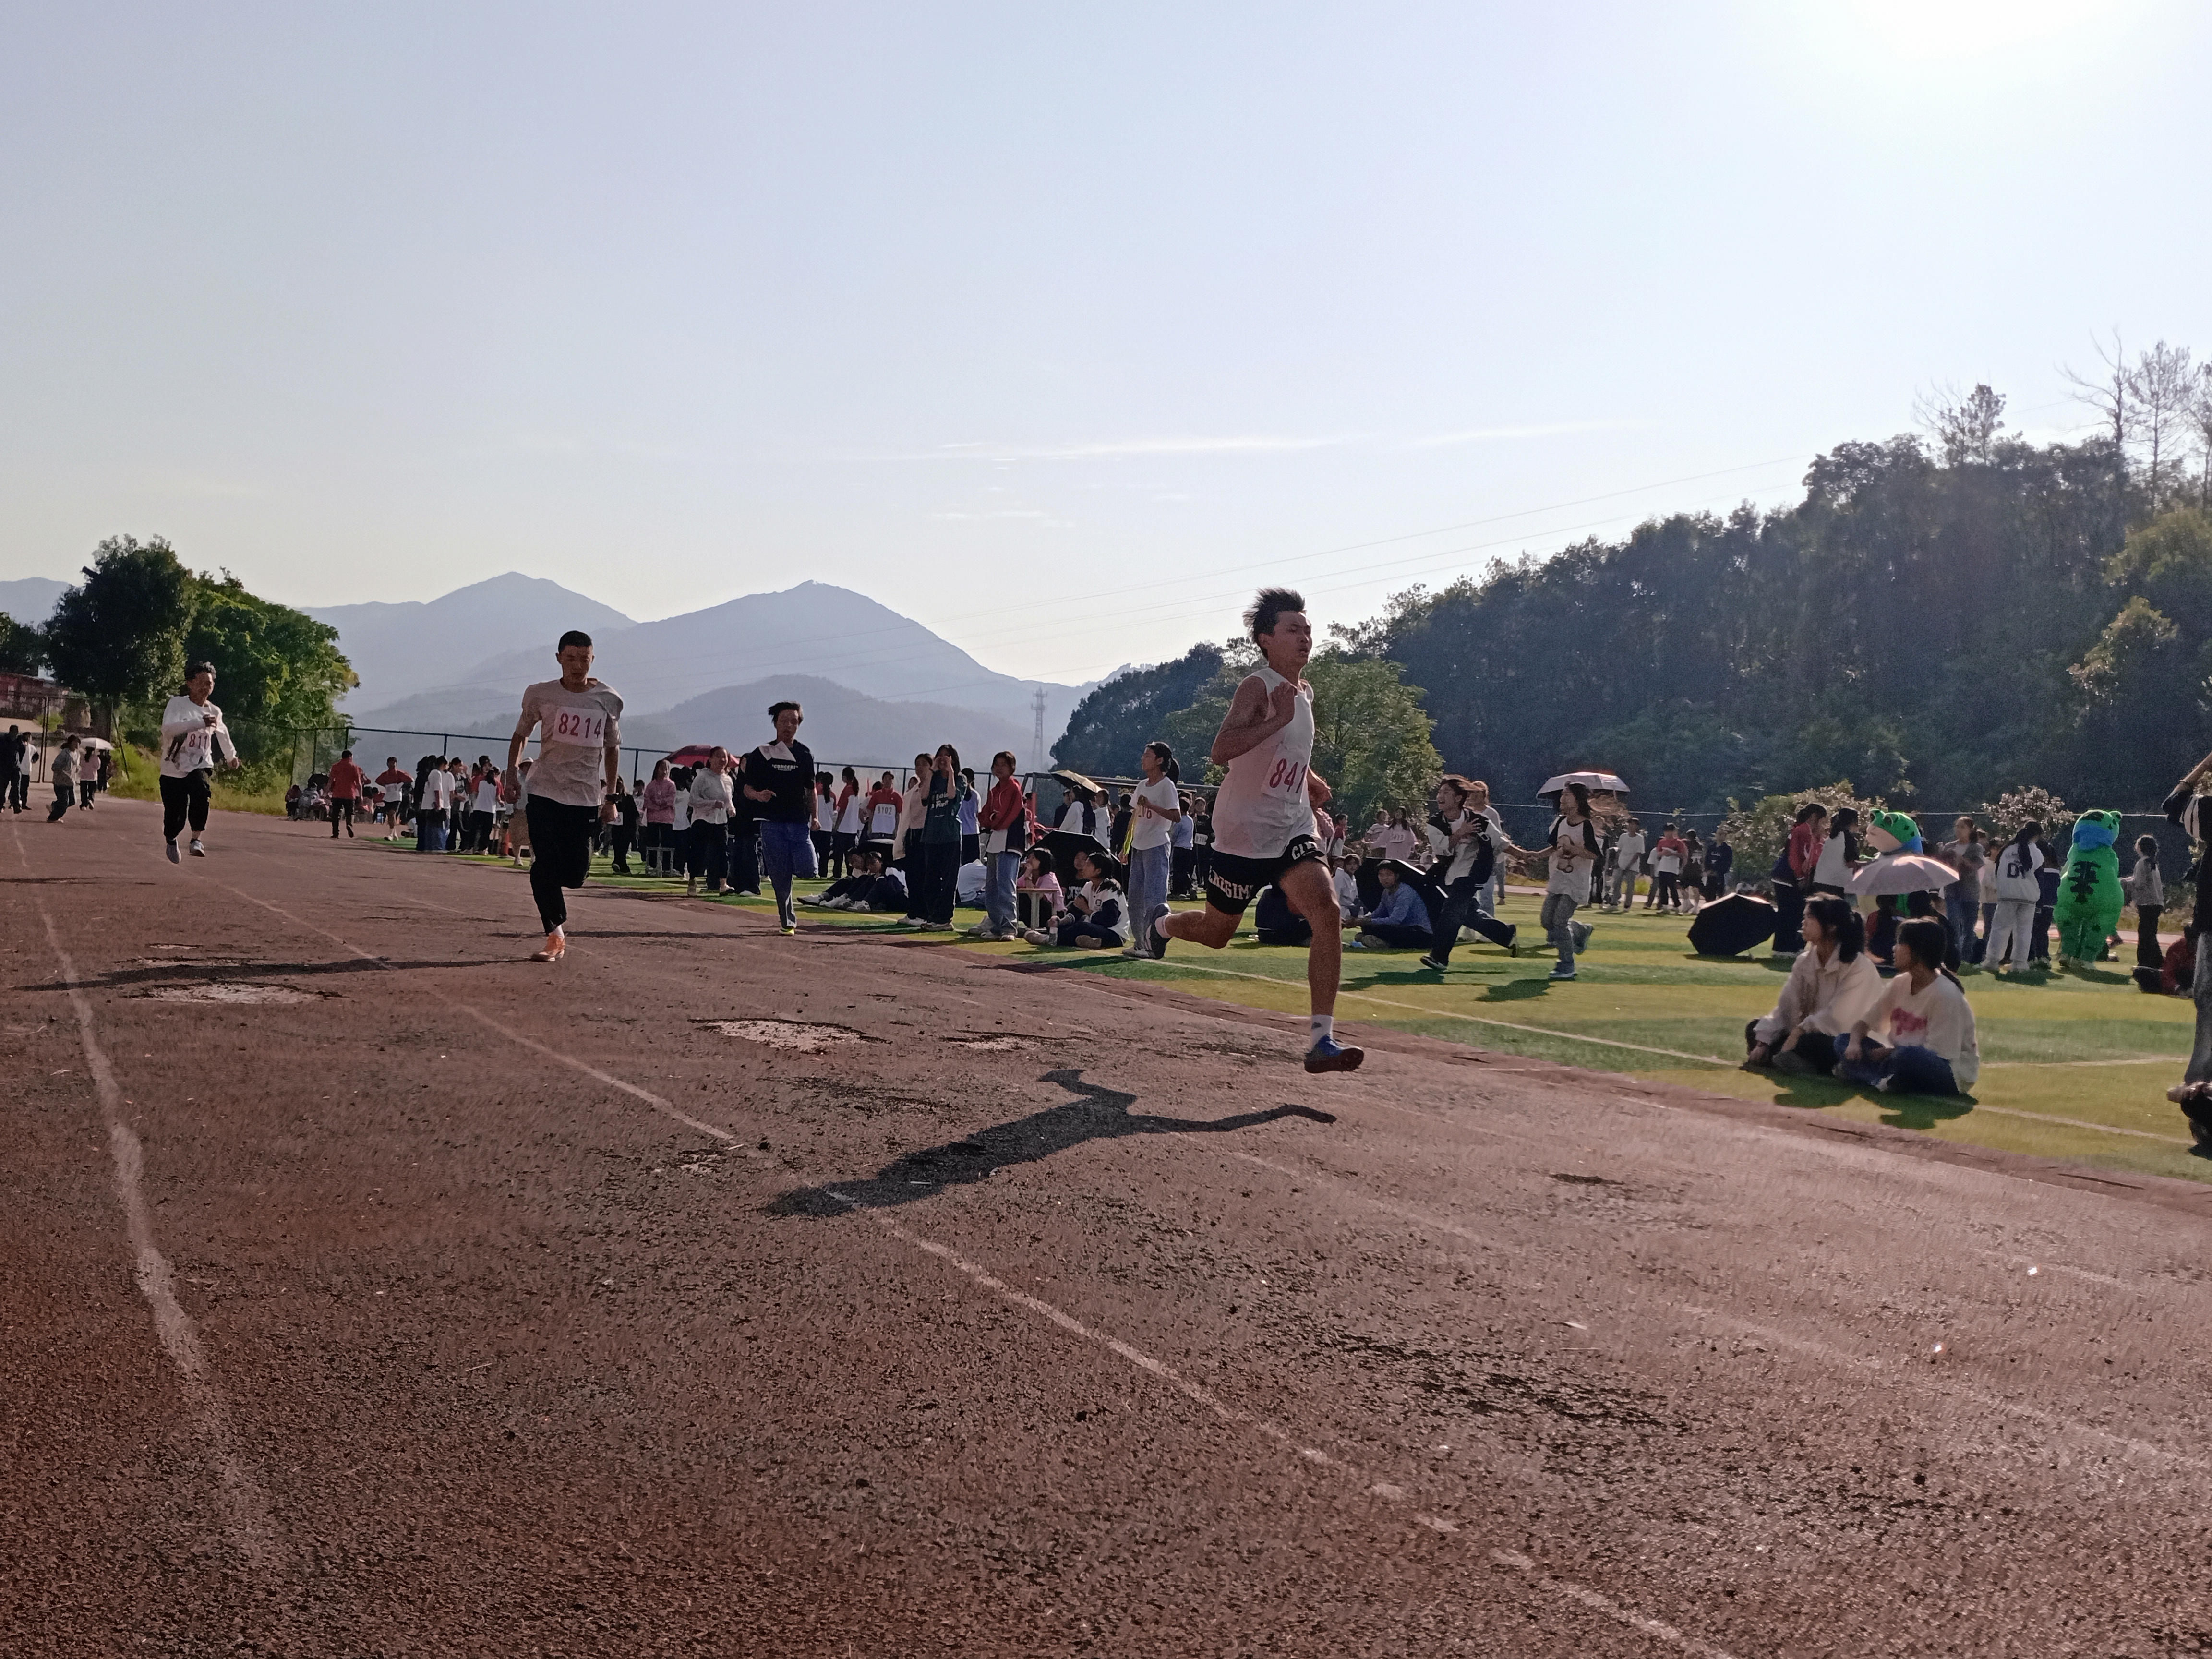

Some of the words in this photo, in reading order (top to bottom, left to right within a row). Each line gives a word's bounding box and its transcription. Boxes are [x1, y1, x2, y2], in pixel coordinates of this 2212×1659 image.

[559, 713, 602, 739] 8214
[189, 733, 208, 749] 811
[1269, 758, 1308, 794] 841
